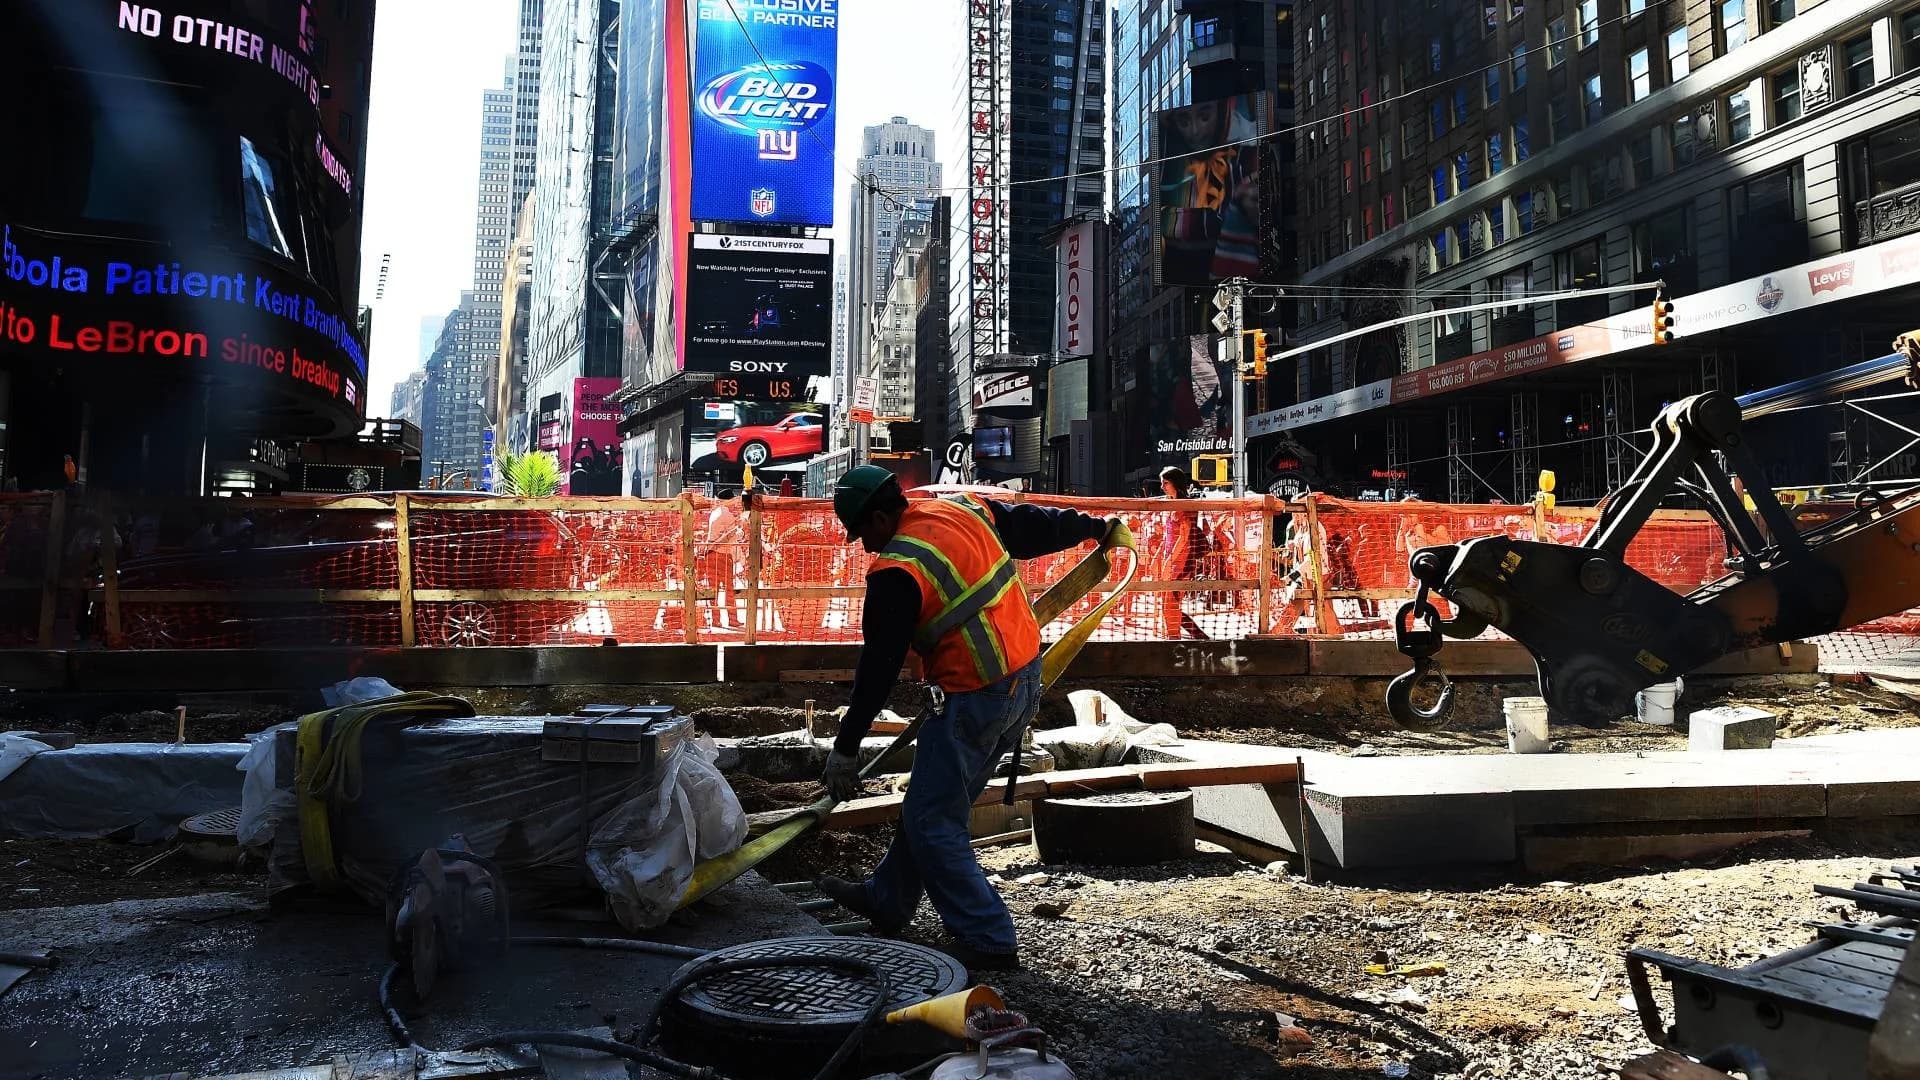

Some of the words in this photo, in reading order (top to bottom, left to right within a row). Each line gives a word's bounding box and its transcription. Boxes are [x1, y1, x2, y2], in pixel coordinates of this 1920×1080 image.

[753, 11, 836, 28] PARTNER
[118, 1, 161, 38] NO
[172, 15, 264, 64] OTHER
[271, 44, 310, 93] NIGHT
[737, 77, 817, 100] BUD
[717, 96, 826, 119] LIGHT
[754, 200, 773, 212] NFL
[734, 239, 752, 248] 21ST
[752, 240, 788, 249] CENTURY
[788, 241, 804, 249] FOX
[4, 223, 89, 293] Ebola
[106, 262, 247, 303] Patient
[255, 276, 300, 322] Kent
[1813, 267, 1850, 287] Levi's
[1068, 234, 1080, 348] RICOH
[8, 307, 35, 343] to
[49, 314, 208, 358] LeBron
[221, 333, 285, 375] since
[291, 348, 341, 398] breakup
[1503, 351, 1516, 363] $50
[1517, 342, 1547, 360] MILLION
[730, 360, 788, 373] SONY
[769, 380, 794, 398] U.S.
[1429, 375, 1454, 391] 168,000
[1454, 373, 1465, 384] RSF
[580, 412, 612, 421] CHOOSE
[1157, 439, 1174, 452] San
[1175, 437, 1214, 452] Cristóbal
[1215, 437, 1227, 449] de
